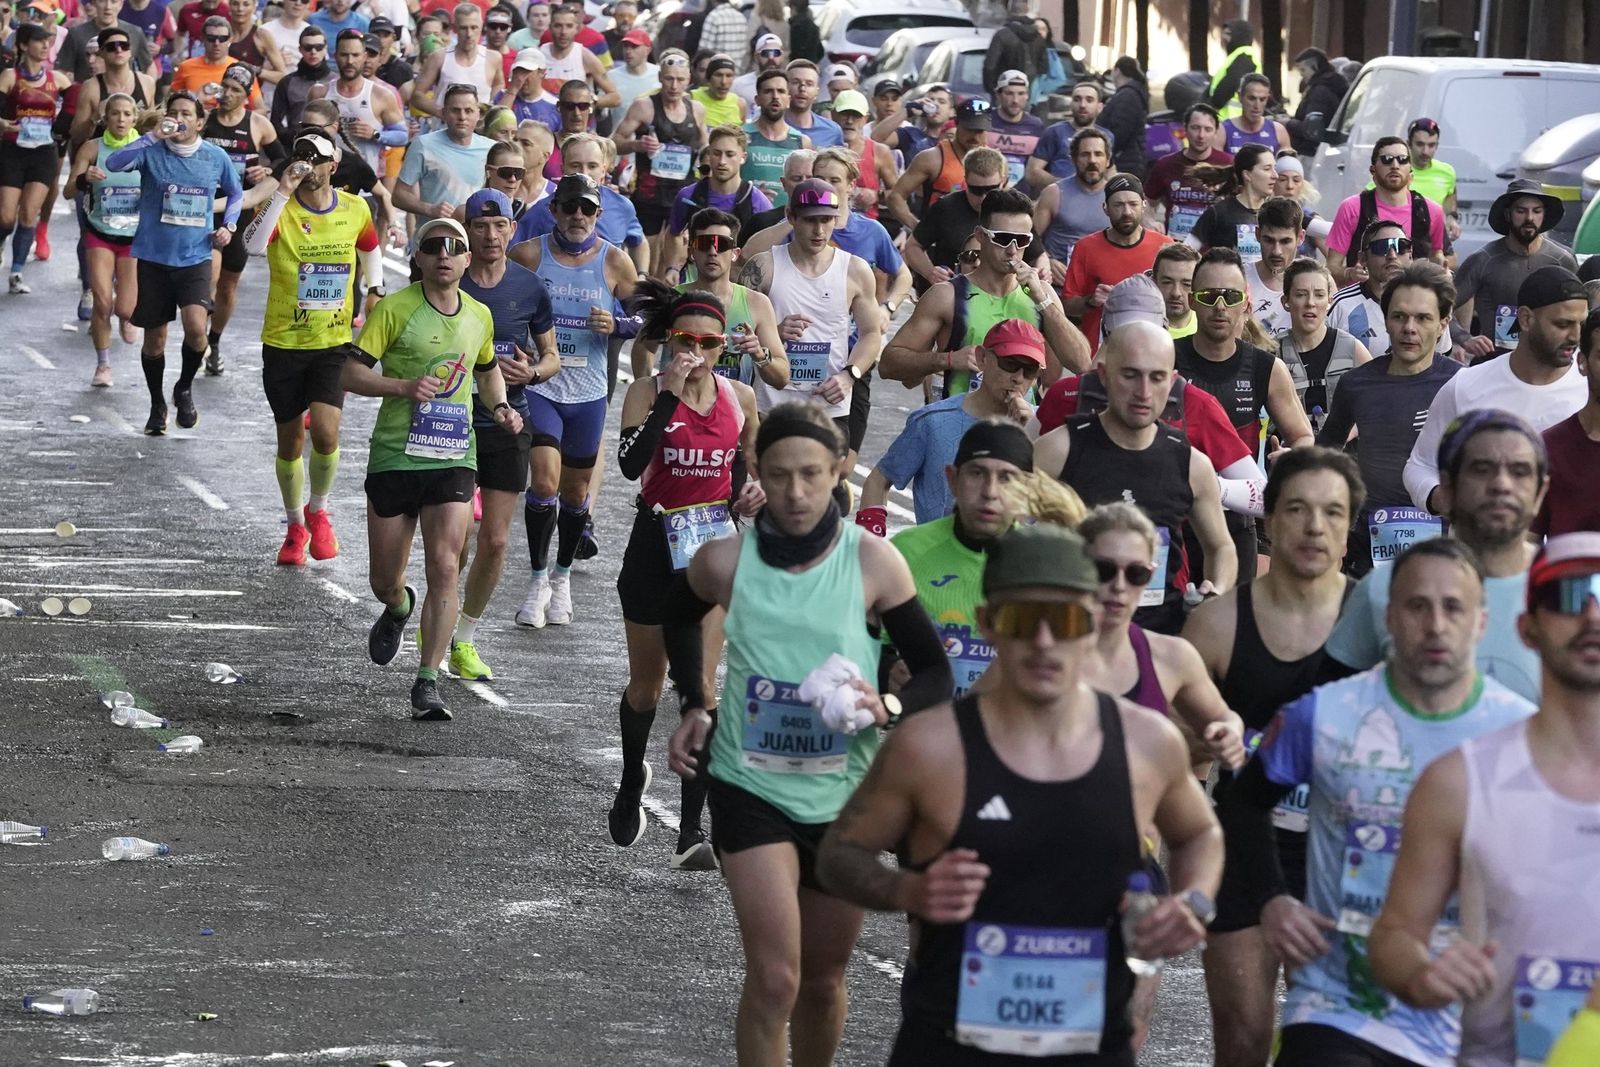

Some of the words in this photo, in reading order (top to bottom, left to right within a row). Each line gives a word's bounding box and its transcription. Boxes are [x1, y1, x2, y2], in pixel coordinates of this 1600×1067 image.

[180, 187, 204, 195] ZURICH
[306, 289, 329, 299] ADRI
[332, 289, 342, 298] JR
[556, 317, 587, 327] ZURICH
[435, 405, 466, 415] ZURICH
[431, 421, 454, 431] 16220
[408, 432, 469, 449] DURANOSEVIC
[672, 468, 721, 478] RUNNING
[1392, 511, 1432, 520] ZURICH
[1393, 529, 1415, 538] 7798
[758, 731, 833, 753] JUANLU
[1013, 934, 1091, 954] ZURICH
[997, 996, 1066, 1024] COKE
